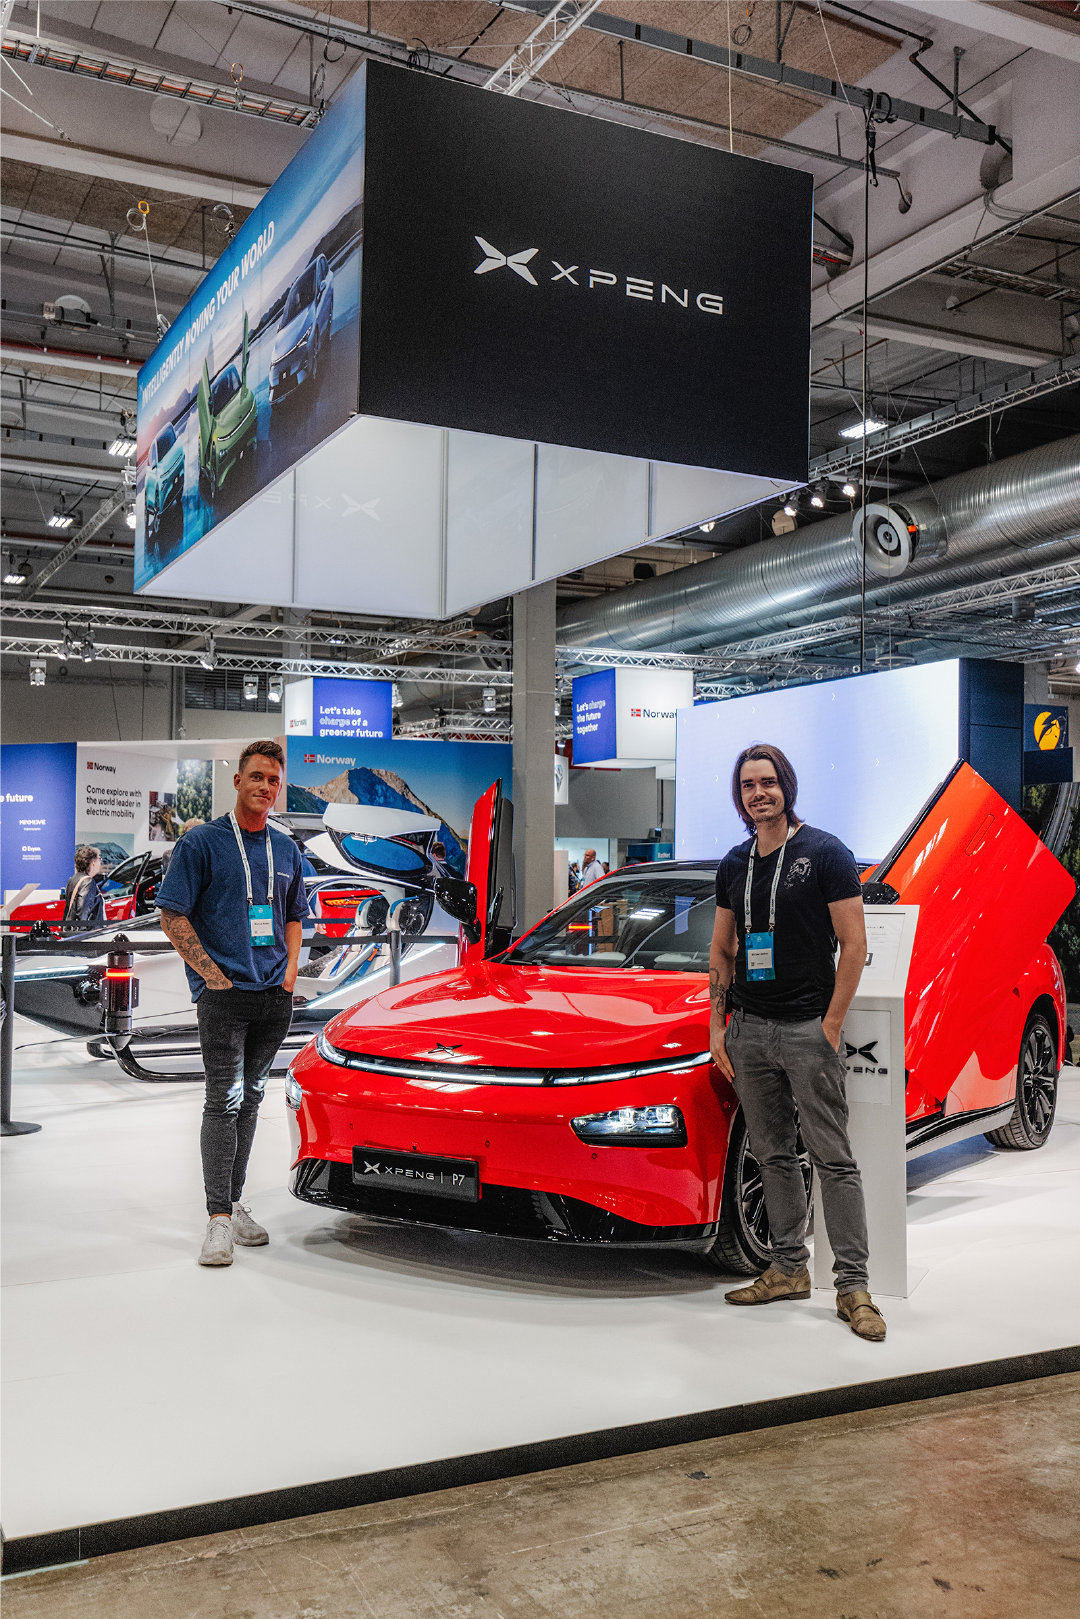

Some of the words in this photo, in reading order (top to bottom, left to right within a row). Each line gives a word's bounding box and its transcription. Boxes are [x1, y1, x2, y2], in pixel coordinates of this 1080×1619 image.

[551, 260, 724, 315] XPENG
[142, 336, 185, 408] INTELLIGENTLY
[184, 297, 216, 353] MOVING
[216, 266, 240, 311] YOUR
[241, 220, 275, 280] WORLD
[320, 705, 341, 715] Let's
[342, 707, 362, 716] take
[319, 716, 351, 728] charge
[351, 718, 362, 727] of
[362, 719, 368, 727] a
[577, 714, 585, 723] the
[586, 712, 601, 721] future
[319, 729, 355, 738] greener
[356, 729, 384, 738] future
[577, 723, 598, 735] together
[316, 754, 357, 767] Norway
[94, 762, 116, 774] Norway
[86, 784, 105, 795] Come
[106, 788, 129, 797] explore
[129, 789, 142, 798] with
[5, 793, 34, 803] future
[86, 795, 98, 805] the
[98, 797, 116, 807] world
[116, 798, 135, 808] leader
[135, 800, 141, 808] in
[86, 807, 110, 817] electric
[110, 809, 135, 820] mobility
[384, 1165, 435, 1181] XPENG
[452, 1173, 466, 1187] P7
